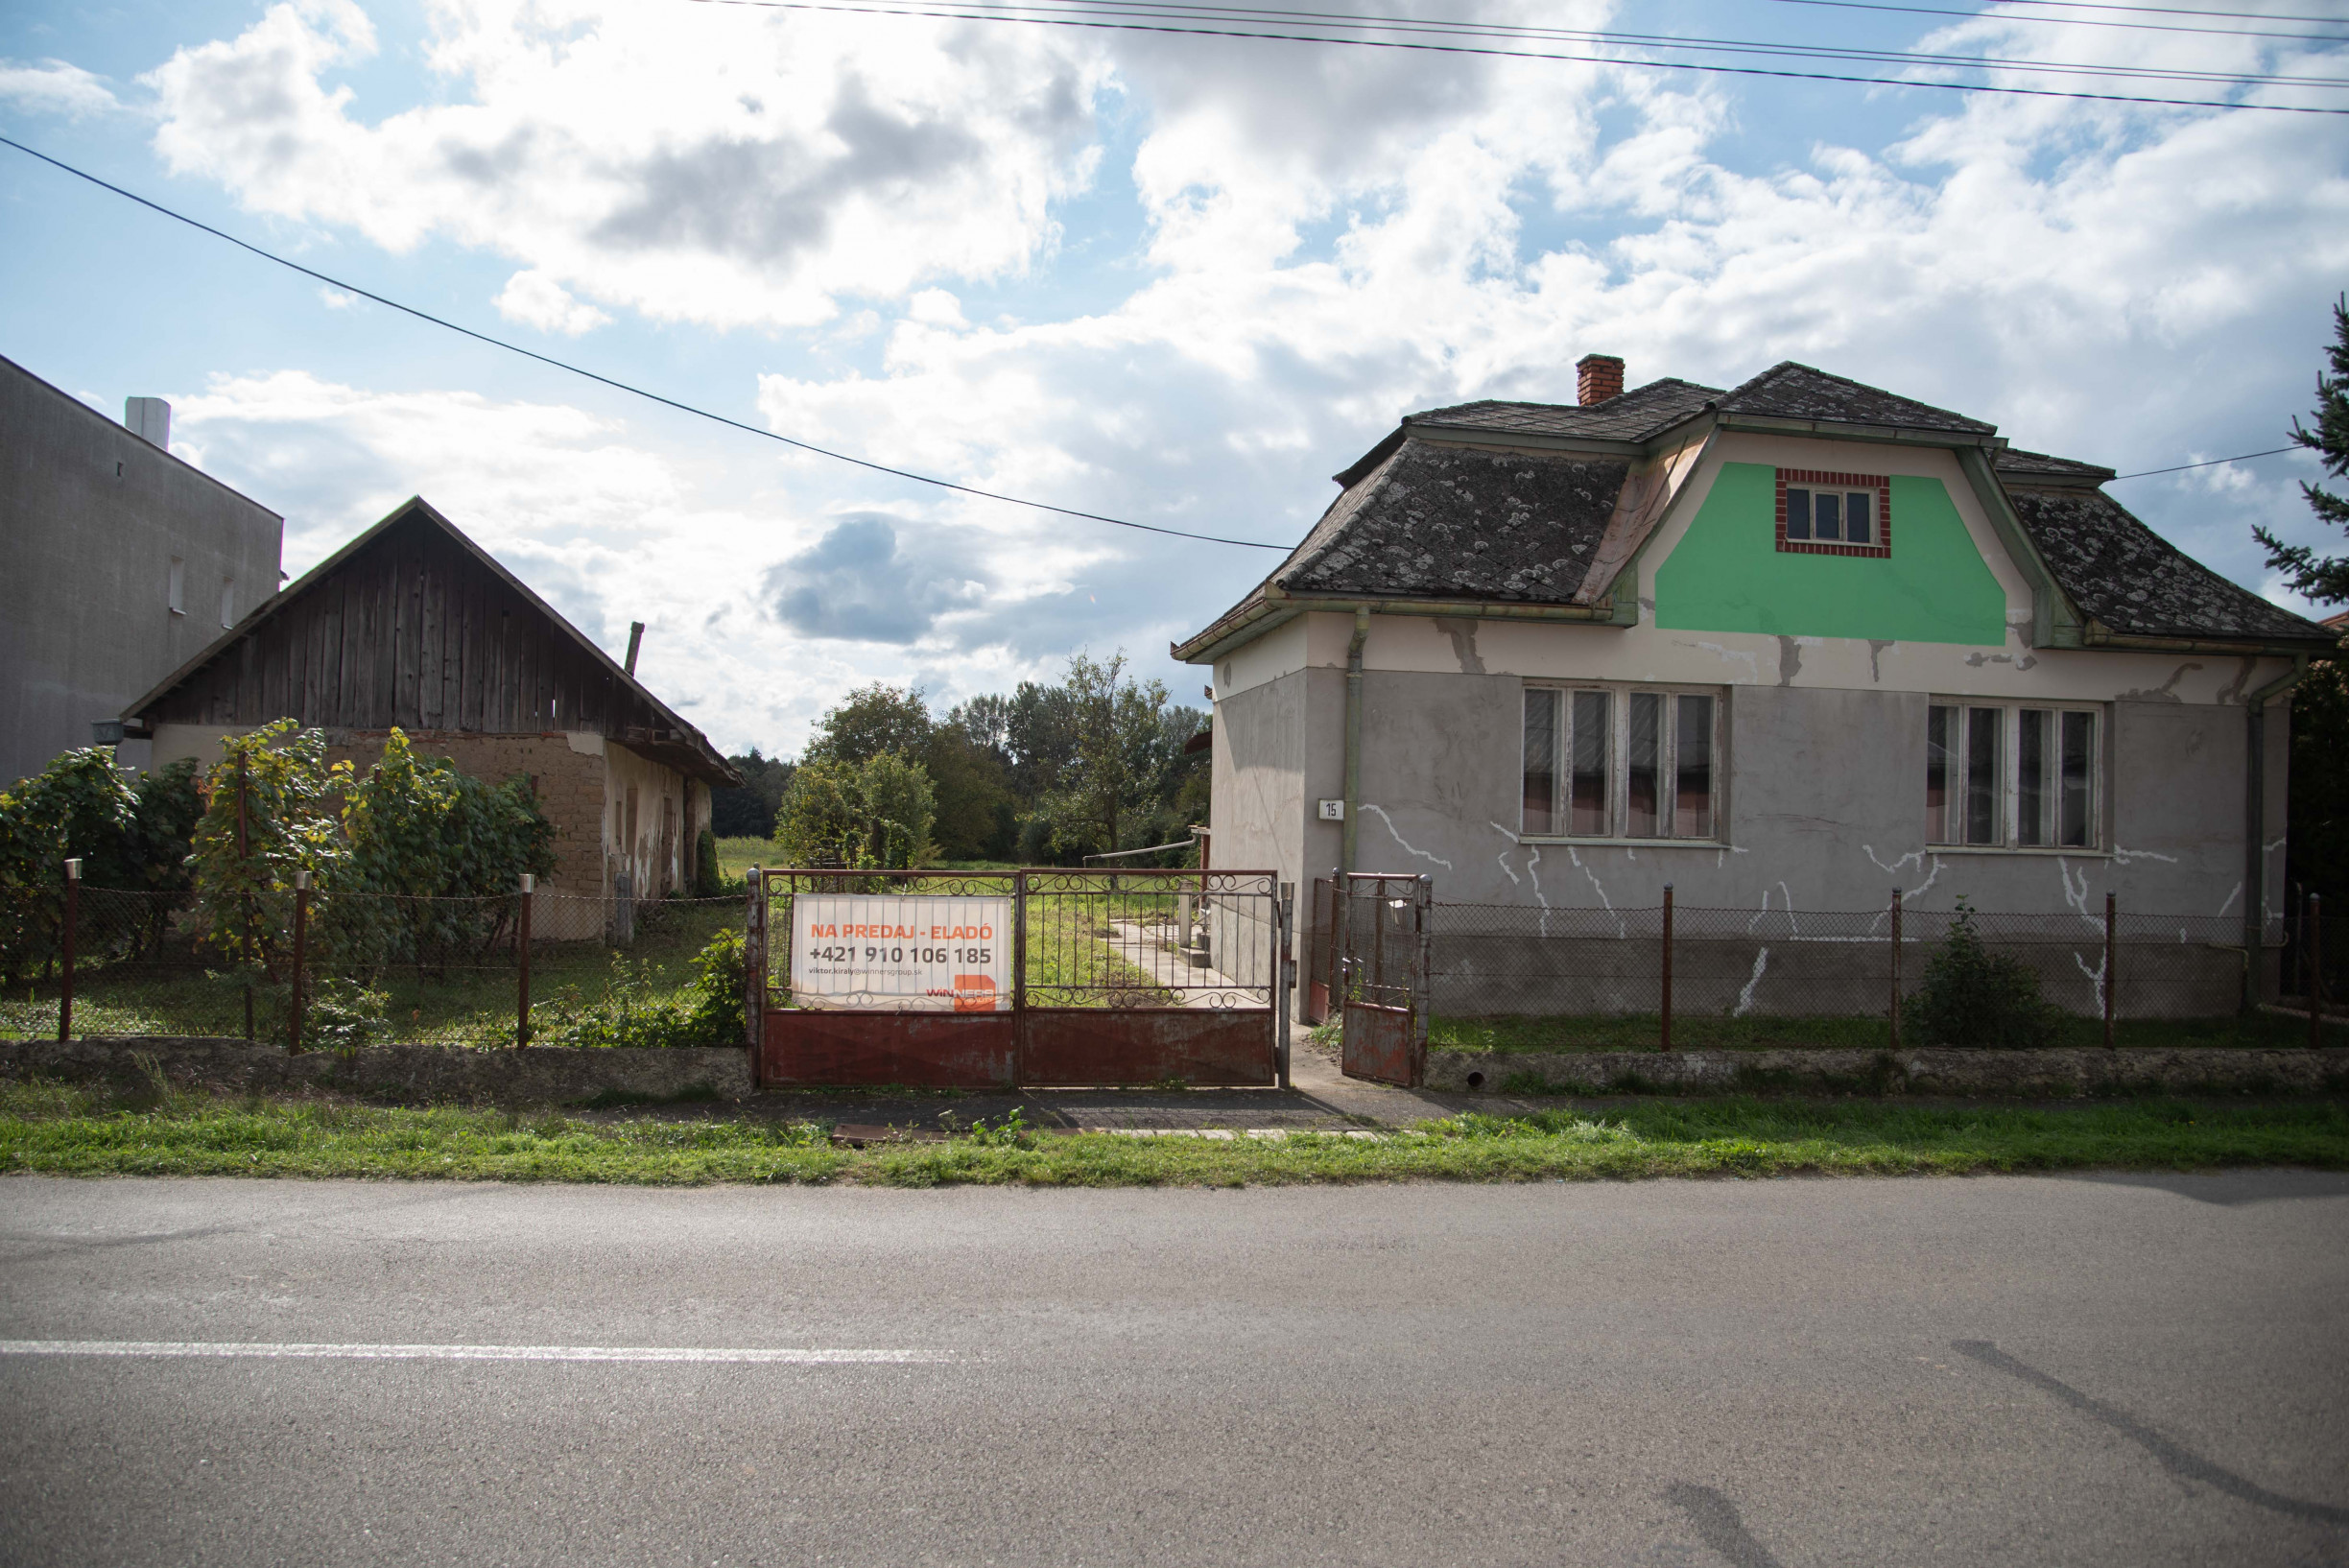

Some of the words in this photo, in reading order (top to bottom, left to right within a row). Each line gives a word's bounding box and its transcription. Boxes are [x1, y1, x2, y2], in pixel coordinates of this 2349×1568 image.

[1326, 803, 1337, 817] 15
[811, 924, 838, 938] NA
[842, 925, 914, 938] PREDAJ
[931, 922, 993, 939] ELADÓ
[810, 946, 856, 962] +421
[866, 947, 903, 962] 910
[911, 948, 947, 963] 106
[955, 949, 991, 963] 185
[809, 967, 922, 976] viktor.kiraly@winnersgroup.sk
